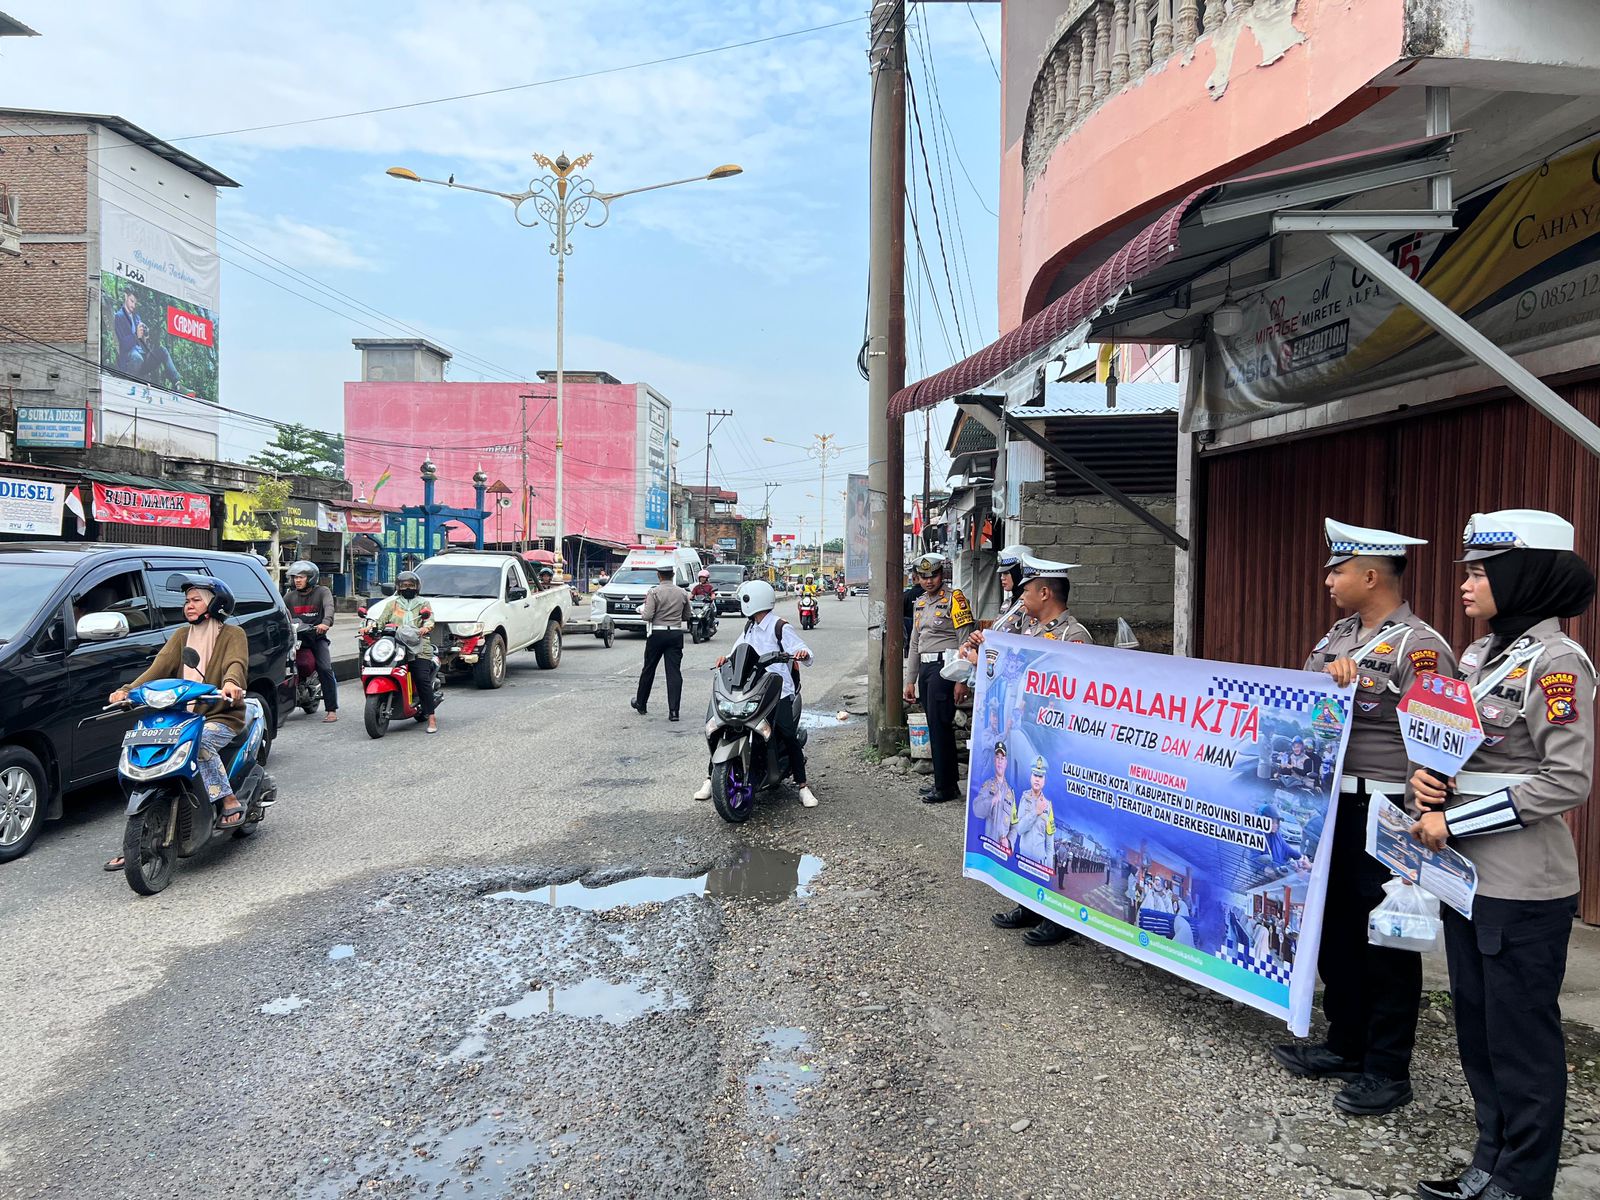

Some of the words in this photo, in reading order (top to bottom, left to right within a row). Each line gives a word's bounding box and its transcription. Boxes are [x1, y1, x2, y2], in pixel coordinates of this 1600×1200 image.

[1512, 204, 1600, 250] CAHAY
[125, 264, 145, 284] Lois
[1302, 299, 1341, 326] MIRETE
[1346, 284, 1381, 307] ALFA
[1540, 280, 1577, 310] 0852
[173, 314, 207, 341] CARDINAL
[27, 409, 54, 421] SURYA
[55, 410, 84, 422] DIESEL
[0, 481, 55, 501] DIESEL
[141, 494, 184, 511] MAMAK
[233, 503, 256, 526] Loi
[287, 507, 302, 516] TOKO
[294, 517, 317, 528] BUSANA
[1358, 658, 1392, 673] POLRI
[1546, 687, 1572, 695] RIAU
[1025, 670, 1077, 700] RIAU
[1082, 680, 1187, 723] ADALAH
[1190, 695, 1260, 742] KITA
[125, 731, 137, 740] BM
[142, 729, 164, 737] 6097
[169, 727, 181, 736] UC
[1037, 707, 1065, 728] KOTA
[1067, 714, 1107, 738] INDAH
[1110, 723, 1159, 749] TERTIB
[1161, 735, 1192, 758] DAN
[1194, 743, 1238, 769] AMAN
[1408, 717, 1441, 747] HELM
[1443, 730, 1464, 756] SNI
[1129, 764, 1187, 790] MEWUJUDKAN
[1062, 763, 1081, 777] LALU
[1082, 769, 1107, 786] LINTAS
[1109, 775, 1130, 792] KOTA
[1135, 784, 1183, 809] KABUPATEN
[1184, 798, 1194, 811] DI
[1196, 803, 1241, 825] PROVINSI
[1244, 814, 1271, 832] RIAU
[1066, 779, 1086, 796] YANG
[1087, 786, 1116, 809] TERTIB,
[1117, 795, 1153, 817] TERATUR
[1154, 809, 1171, 823] DAN
[1173, 812, 1265, 850] BERKESELAMATAN
